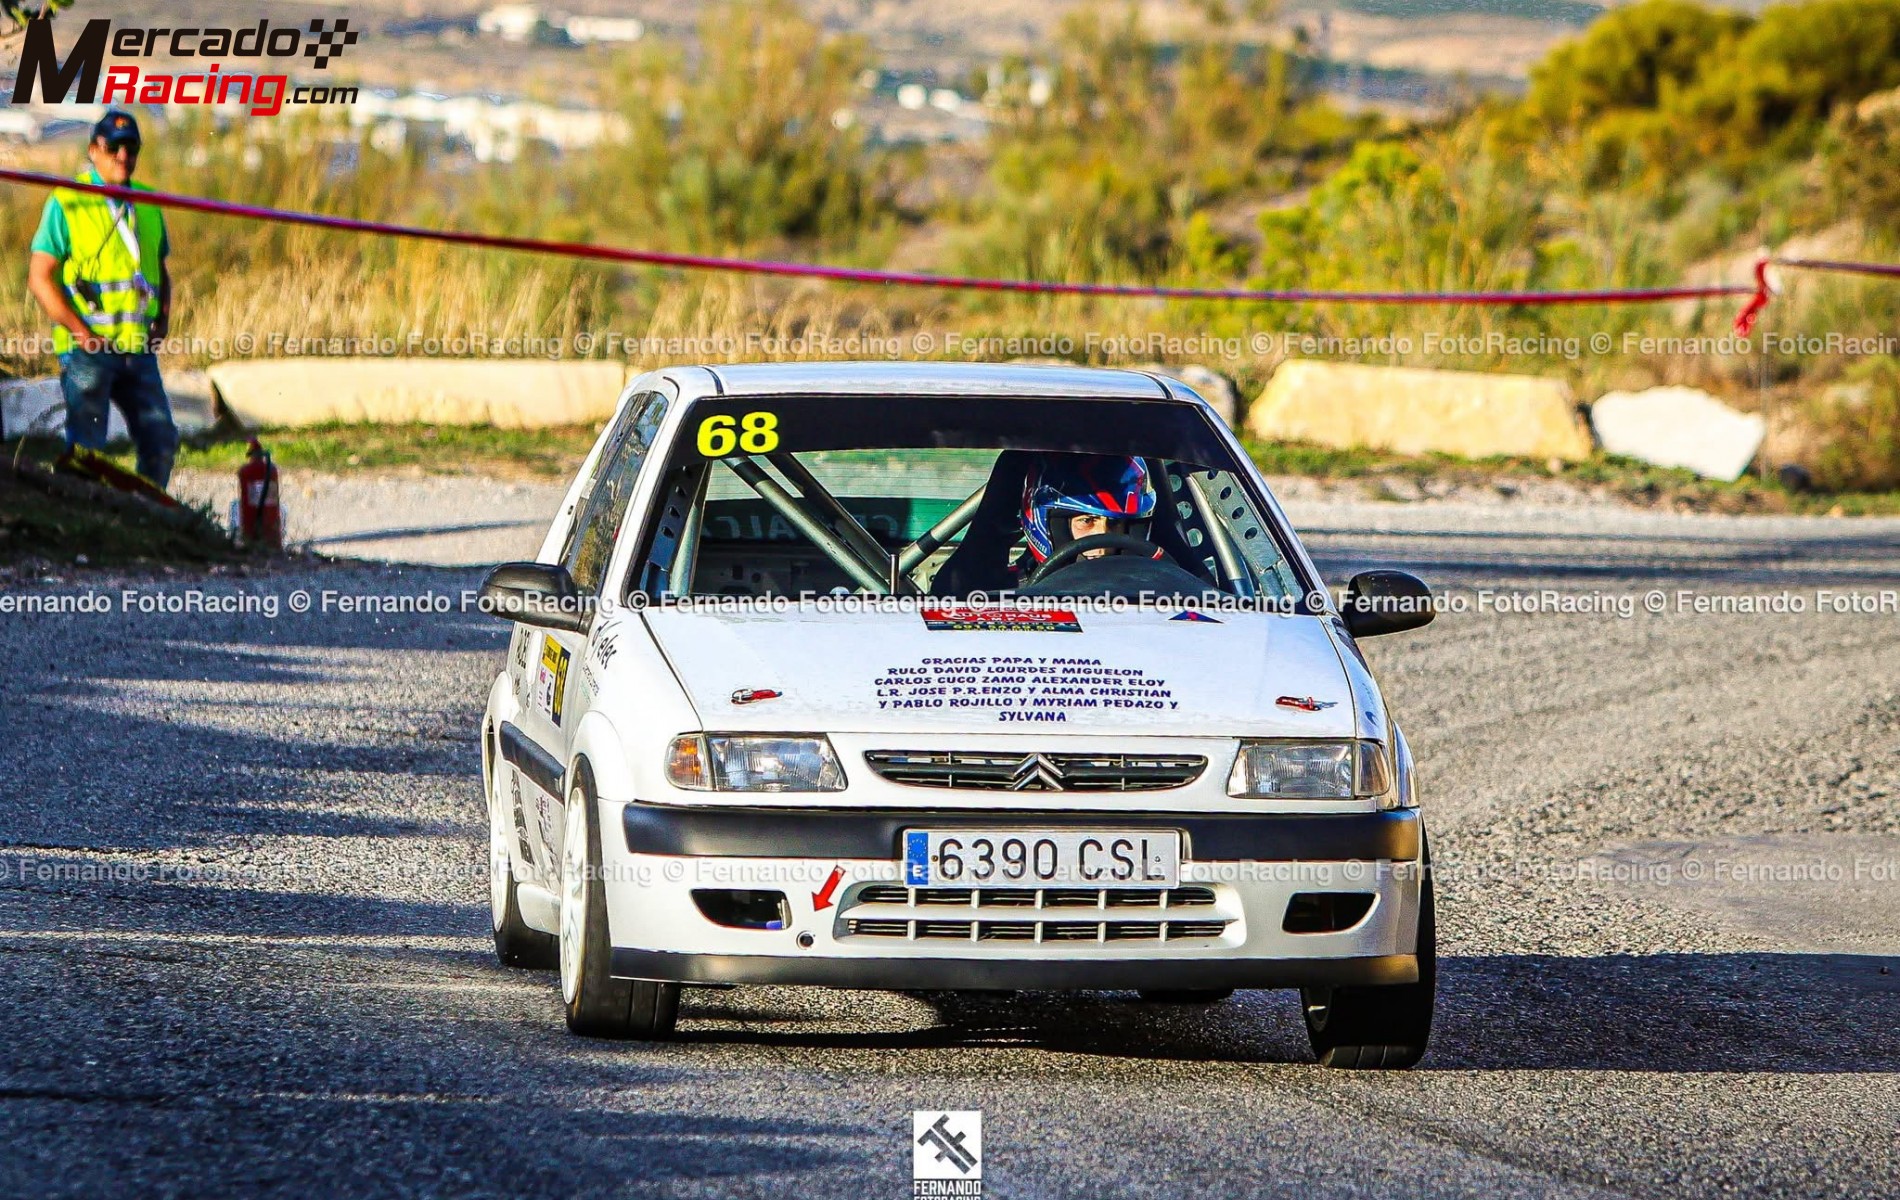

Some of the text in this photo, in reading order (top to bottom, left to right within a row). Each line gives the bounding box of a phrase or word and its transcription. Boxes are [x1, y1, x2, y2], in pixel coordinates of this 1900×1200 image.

[697, 411, 779, 457] 68
[922, 657, 986, 665] GRACIAS
[1052, 658, 1102, 666] MAMA
[887, 666, 1143, 676] RULO DAVID LOURDES MIGUELON
[874, 676, 1165, 687] CARLOS CUCO ZAMO ALEXANDER ELOY
[877, 688, 903, 697] L.R.
[908, 687, 947, 695] JOSE
[1041, 687, 1085, 695] ALMA
[1089, 688, 1171, 698] CHRISTIAN
[879, 698, 1178, 710] Y PABLO ROJILLO Y MYRIAM PEDAZO Y
[998, 711, 1067, 722] SYLVANA
[938, 838, 1166, 881] 6390 CSL
[911, 864, 923, 878] E
